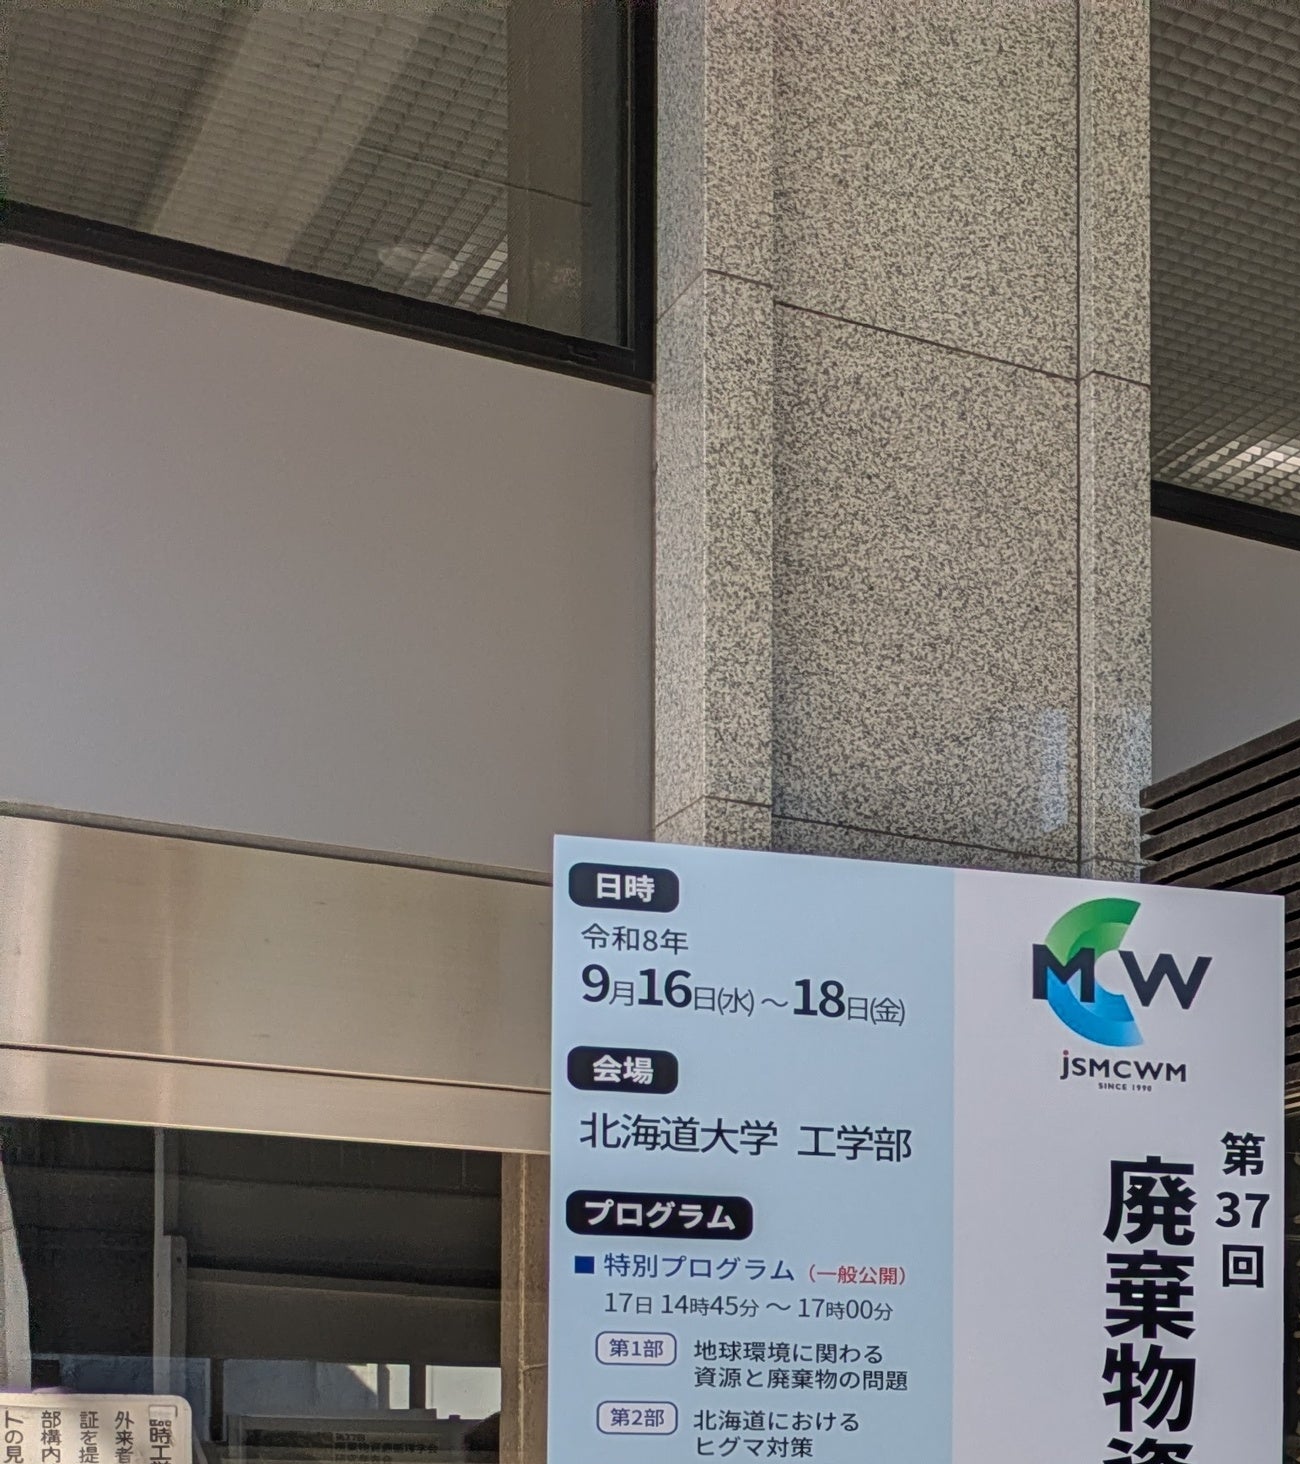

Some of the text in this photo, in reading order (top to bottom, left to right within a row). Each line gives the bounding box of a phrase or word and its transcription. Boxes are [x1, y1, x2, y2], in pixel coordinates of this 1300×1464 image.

[595, 871, 655, 903] 日時
[580, 922, 690, 956] 令和8年
[591, 1053, 655, 1086] 会場
[1097, 1082, 1153, 1093] SINCE 1990
[579, 1111, 914, 1163] 北海道大学 工学部
[584, 1197, 737, 1232] プログラム
[1214, 1130, 1271, 1290] 第37回
[603, 1252, 907, 1287] 特別プログラム （一般公開）
[608, 1338, 884, 1366] 第1部 地球環境に関わる
[693, 1365, 909, 1392] 資源と廃棄物の問題
[609, 1407, 861, 1434] 第2部 北海道における
[696, 1435, 814, 1460] ヒグマ対策
